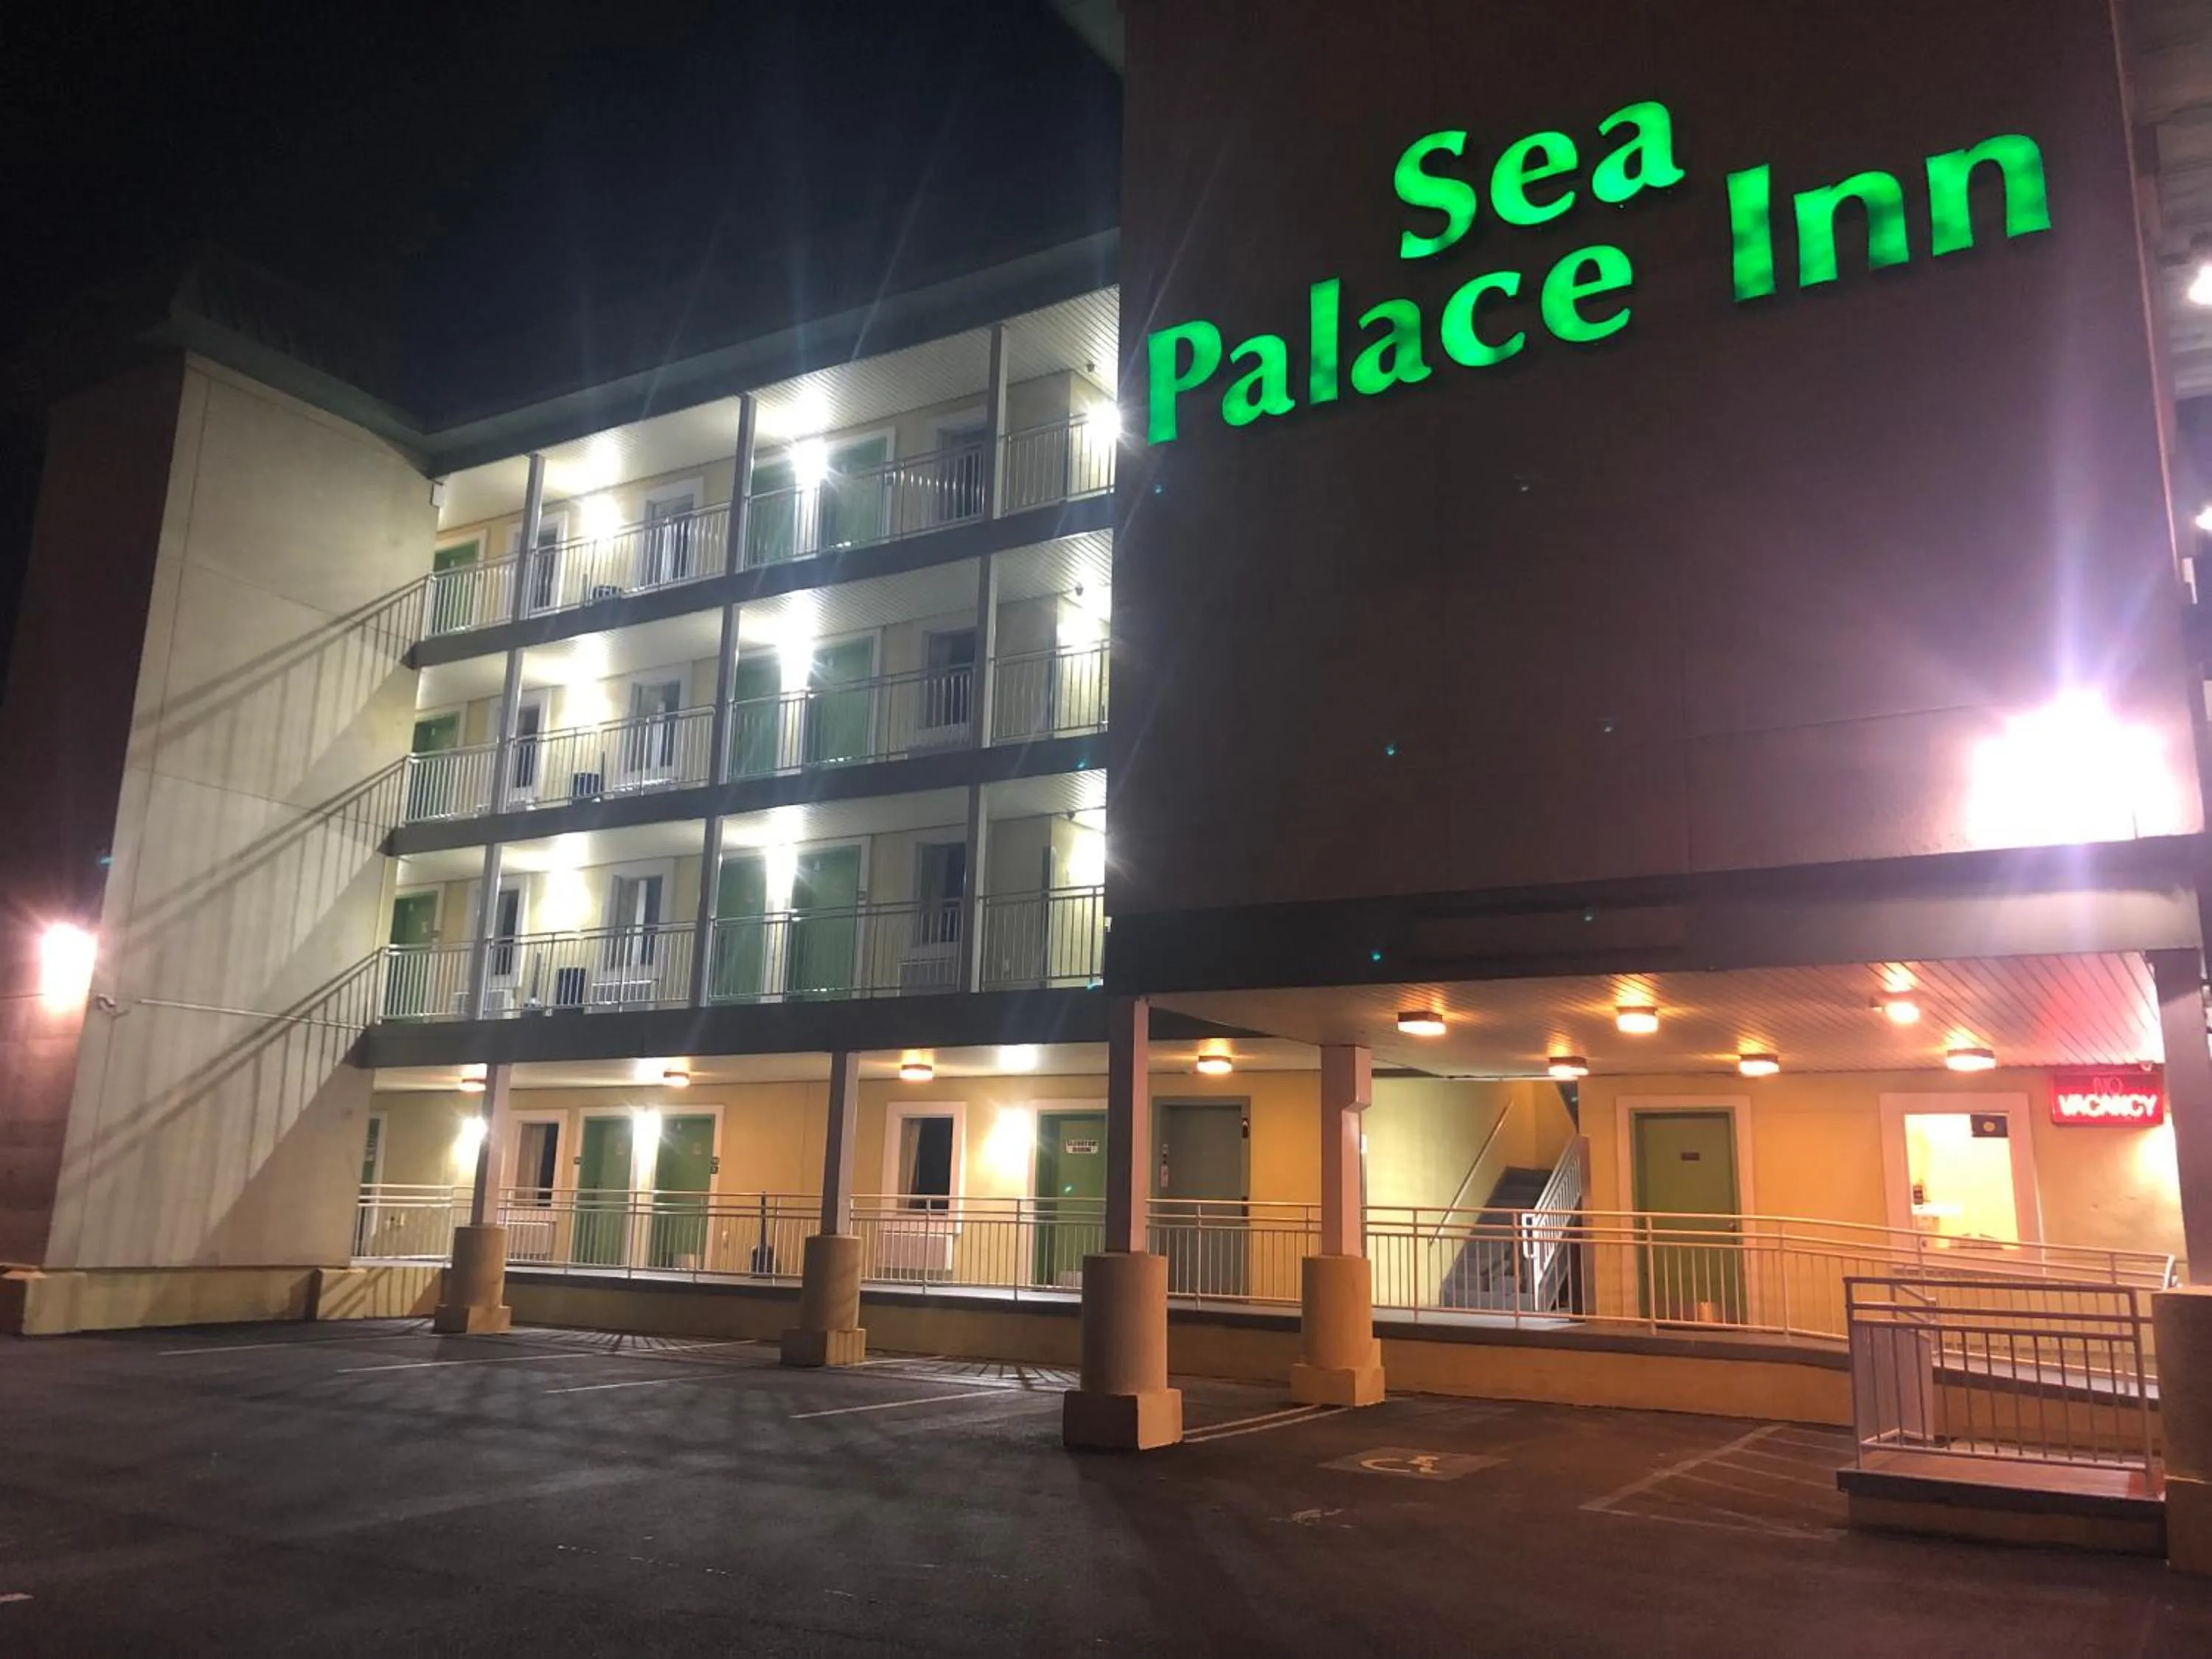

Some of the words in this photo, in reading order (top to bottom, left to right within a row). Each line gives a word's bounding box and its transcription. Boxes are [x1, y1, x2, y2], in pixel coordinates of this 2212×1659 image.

[1394, 100, 1686, 260] Sea
[1146, 244, 1633, 446] Palace
[1727, 133, 2052, 302] Inn
[2058, 1093, 2157, 1118] VACANCY
[2093, 1077, 2124, 1095] NO
